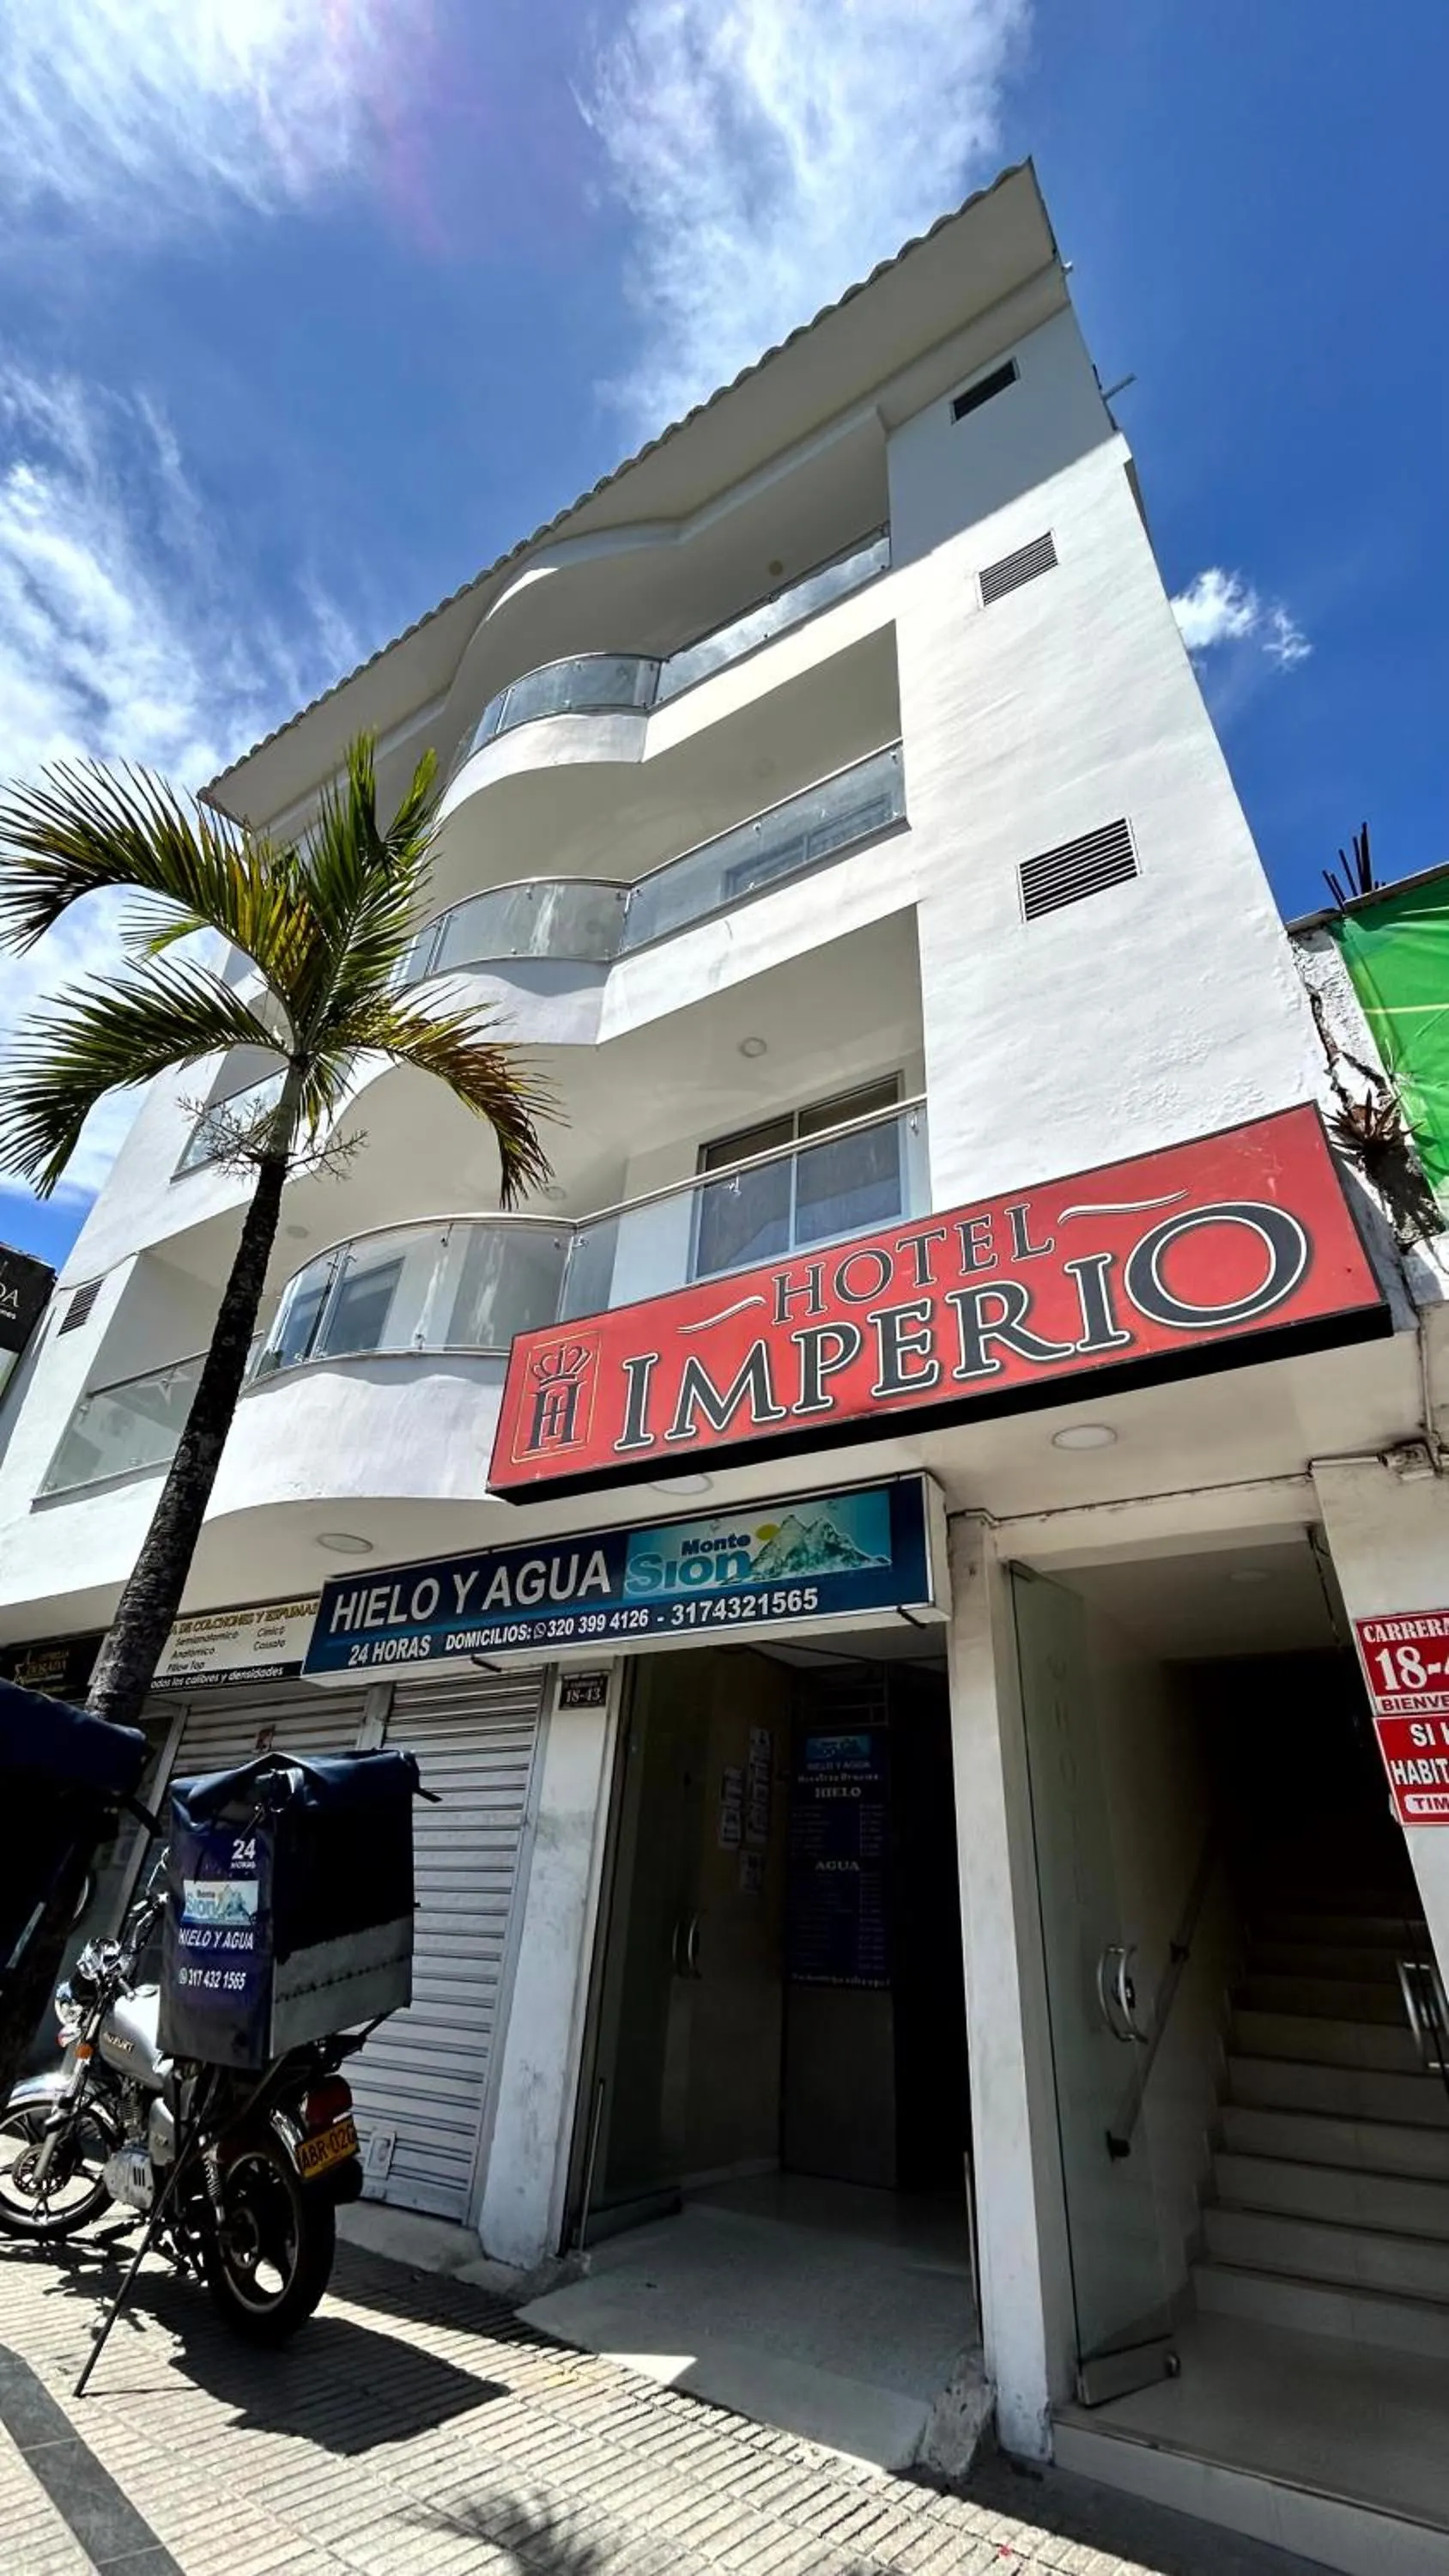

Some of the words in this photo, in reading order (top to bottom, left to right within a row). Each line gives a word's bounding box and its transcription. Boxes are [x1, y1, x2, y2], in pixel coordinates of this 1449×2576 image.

[771, 1204, 1055, 1327] HOTEL
[613, 1200, 1313, 1452] IMPERIO
[681, 1532, 751, 1556] Monte
[623, 1549, 752, 1595] Sion
[330, 1577, 440, 1632] HIELO
[452, 1571, 480, 1614] Y
[482, 1550, 611, 1610] AGUA
[348, 1643, 369, 1666] 24
[372, 1634, 432, 1663] HORAS
[445, 1624, 531, 1651] DOMICILIOS:
[547, 1619, 573, 1638] 320
[578, 1613, 605, 1633] 399
[609, 1607, 649, 1630] 4126
[671, 1587, 818, 1626] 3174321565
[1374, 1645, 1449, 1691] 18-
[151, 1678, 171, 1689] odos
[1410, 1722, 1436, 1747] SI
[815, 1786, 862, 1799] HIELO
[231, 1837, 256, 1859] 24
[815, 1860, 861, 1873] AGUA
[178, 1928, 211, 1947] HIELO
[213, 1931, 222, 1948] Y
[221, 1931, 253, 1950] AGUA
[189, 1968, 203, 1987] 317
[203, 1970, 221, 1989] 432
[222, 1971, 246, 1991] 1565
